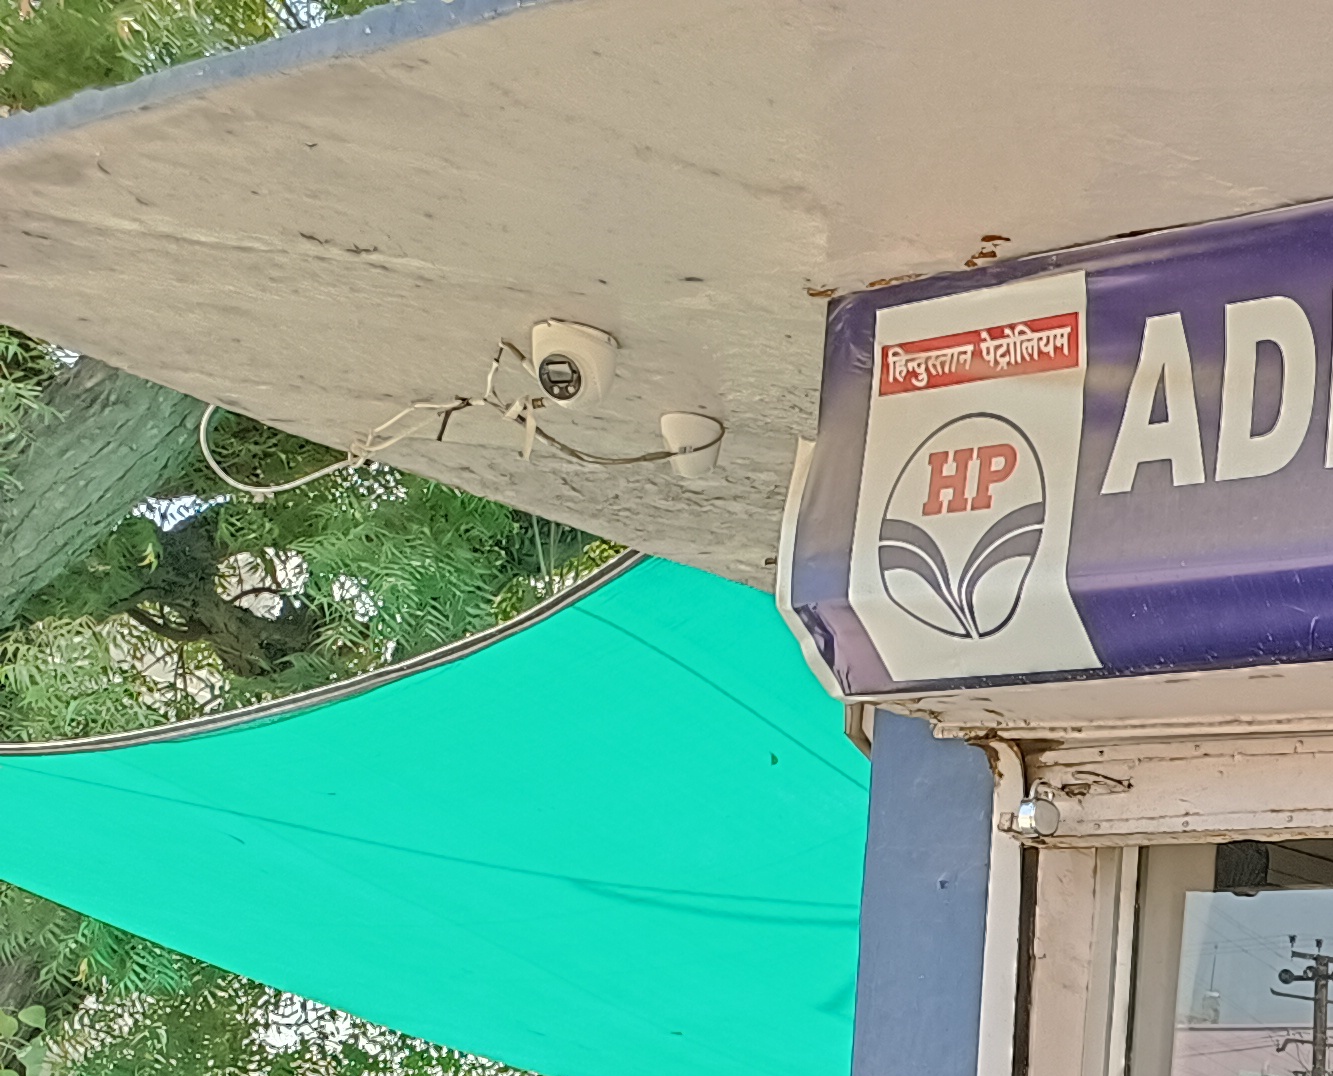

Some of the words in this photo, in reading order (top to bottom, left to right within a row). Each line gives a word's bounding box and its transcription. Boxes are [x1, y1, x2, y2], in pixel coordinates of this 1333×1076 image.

[887, 344, 974, 387] हिन्दुस्तान
[979, 324, 1072, 372] पेट्रोलियम
[923, 444, 1017, 516] HP
